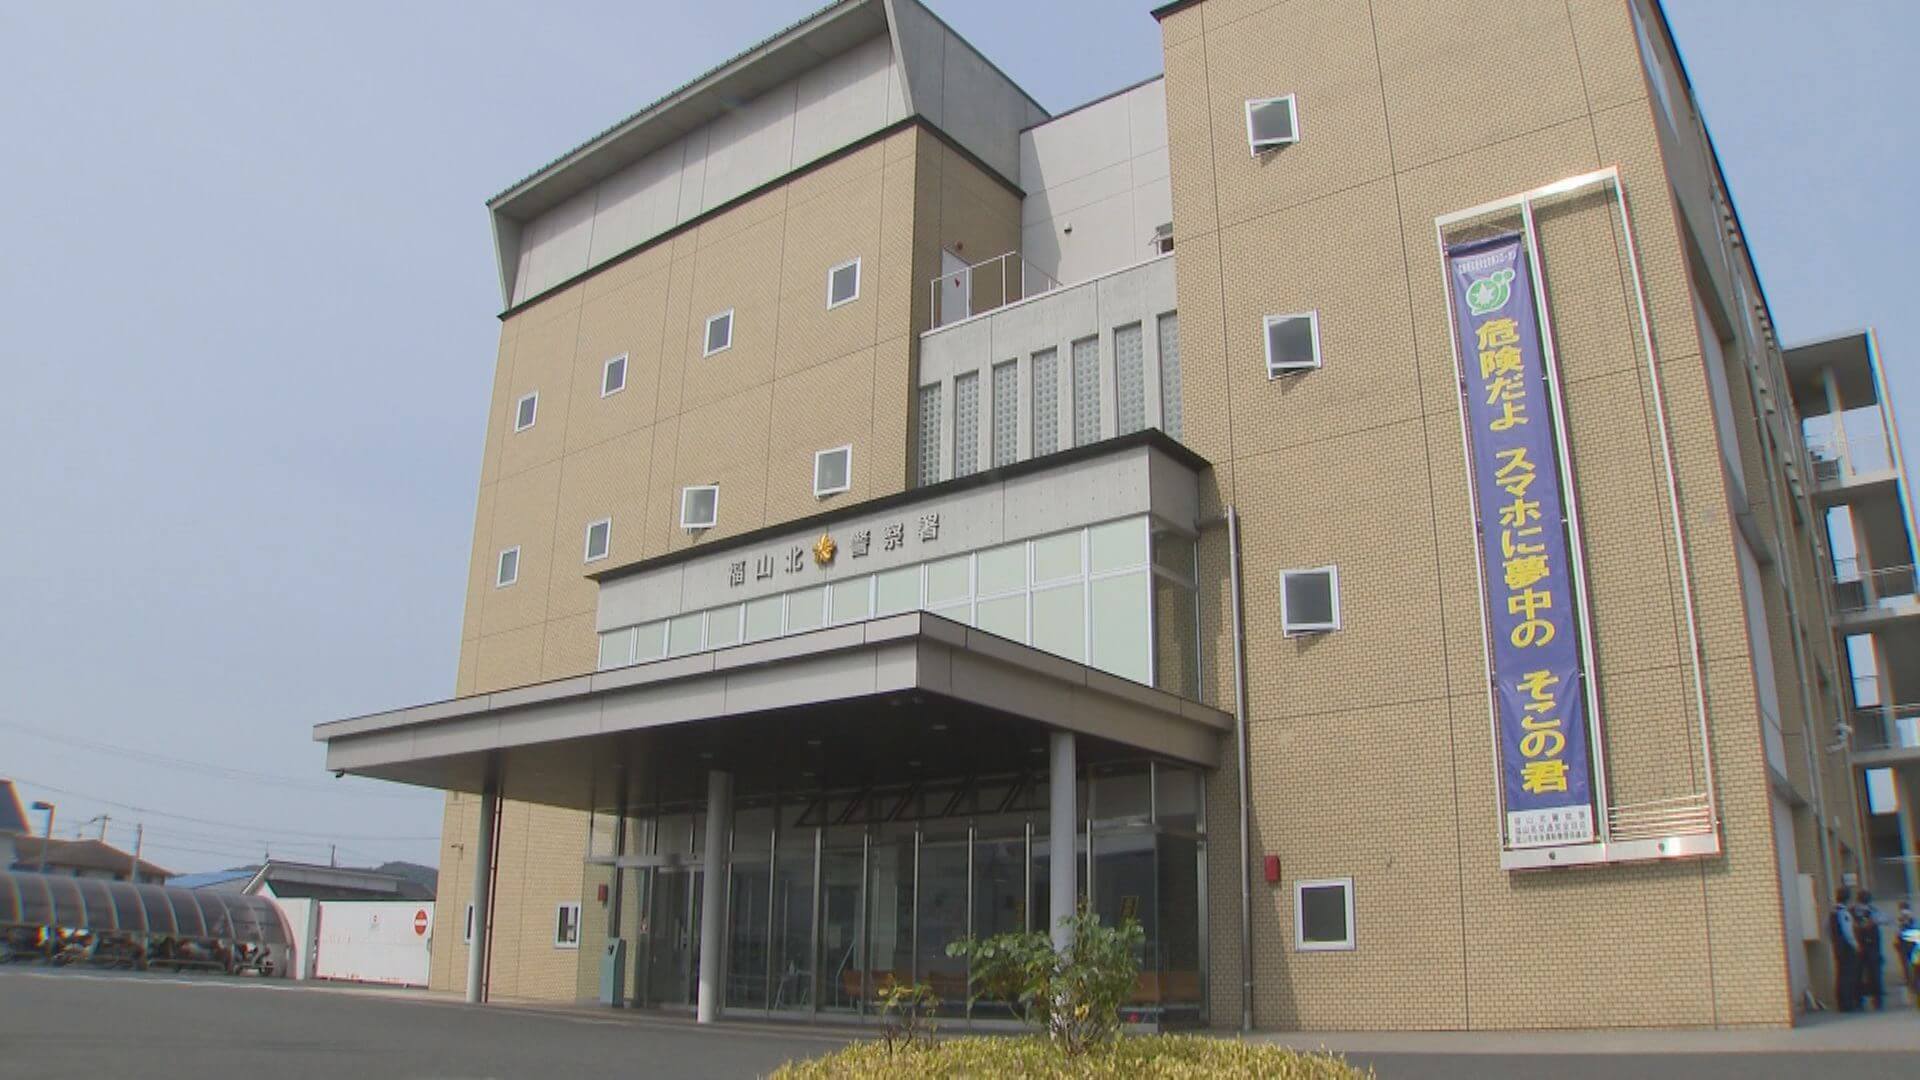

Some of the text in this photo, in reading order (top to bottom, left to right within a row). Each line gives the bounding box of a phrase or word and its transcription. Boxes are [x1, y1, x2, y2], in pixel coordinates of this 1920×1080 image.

[1475, 318, 1529, 431] 危険だよ
[729, 511, 941, 588] 福山北 警察署
[1495, 447, 1556, 648] スマホに夢中の
[1517, 669, 1569, 794] そこの君
